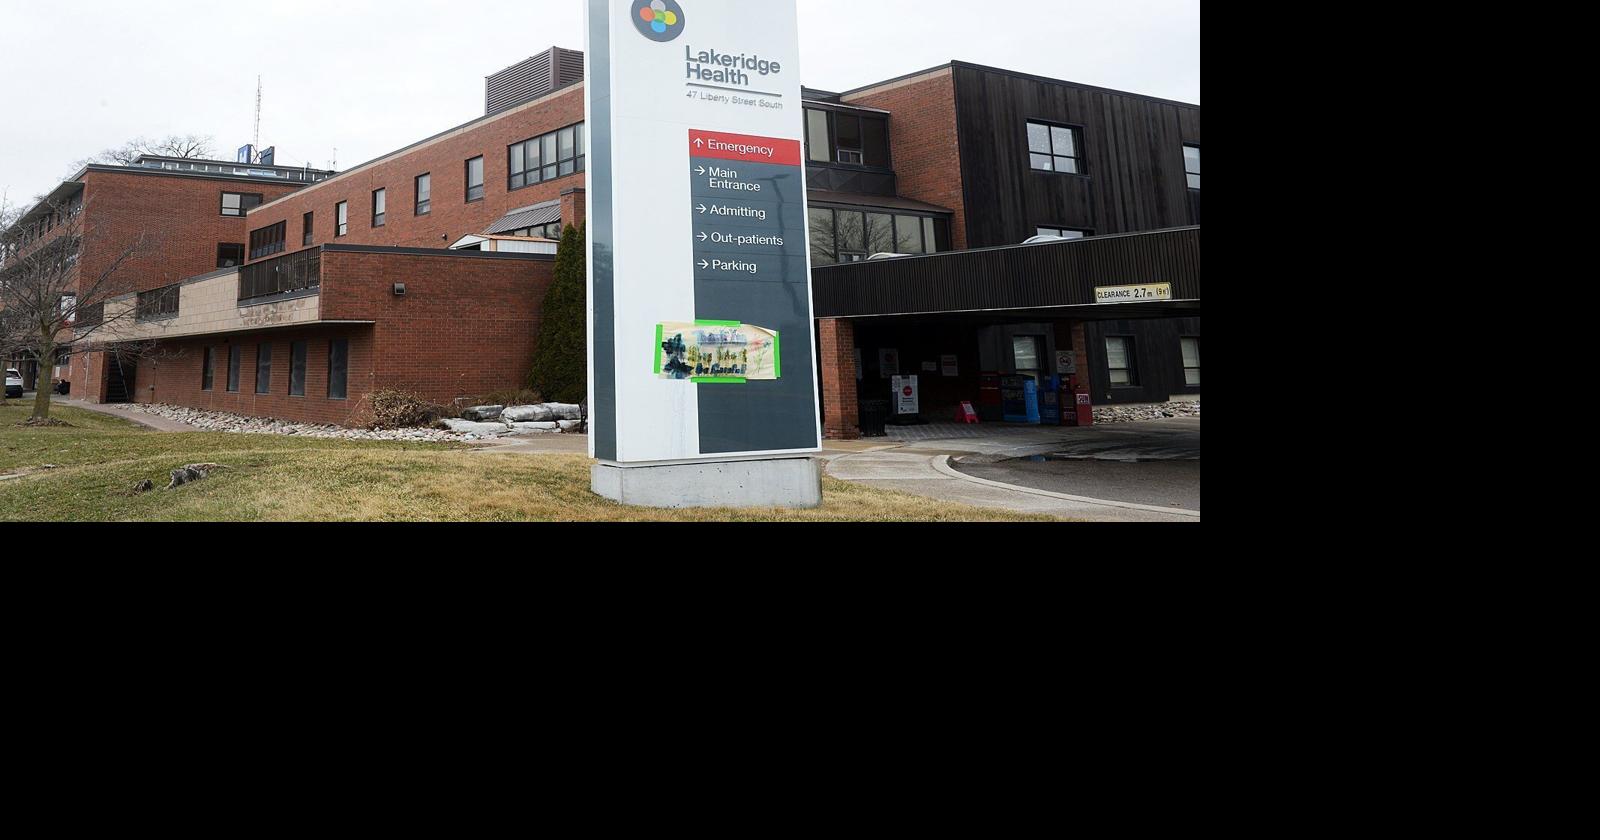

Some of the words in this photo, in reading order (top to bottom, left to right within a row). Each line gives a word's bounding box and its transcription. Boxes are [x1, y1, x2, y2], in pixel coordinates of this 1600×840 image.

[685, 45, 781, 75] Lakeridge
[686, 62, 748, 86] Health
[686, 90, 697, 98] 47
[700, 91, 729, 104] Liberty
[732, 95, 757, 106] Street
[759, 98, 783, 109] South
[708, 138, 774, 158] Emergency
[708, 166, 737, 179] Main
[709, 178, 761, 192] Entrance
[709, 204, 766, 220] Admitting
[710, 231, 784, 246] Out-patients
[712, 259, 757, 273] Parking
[1097, 289, 1131, 299] CLEARANCE
